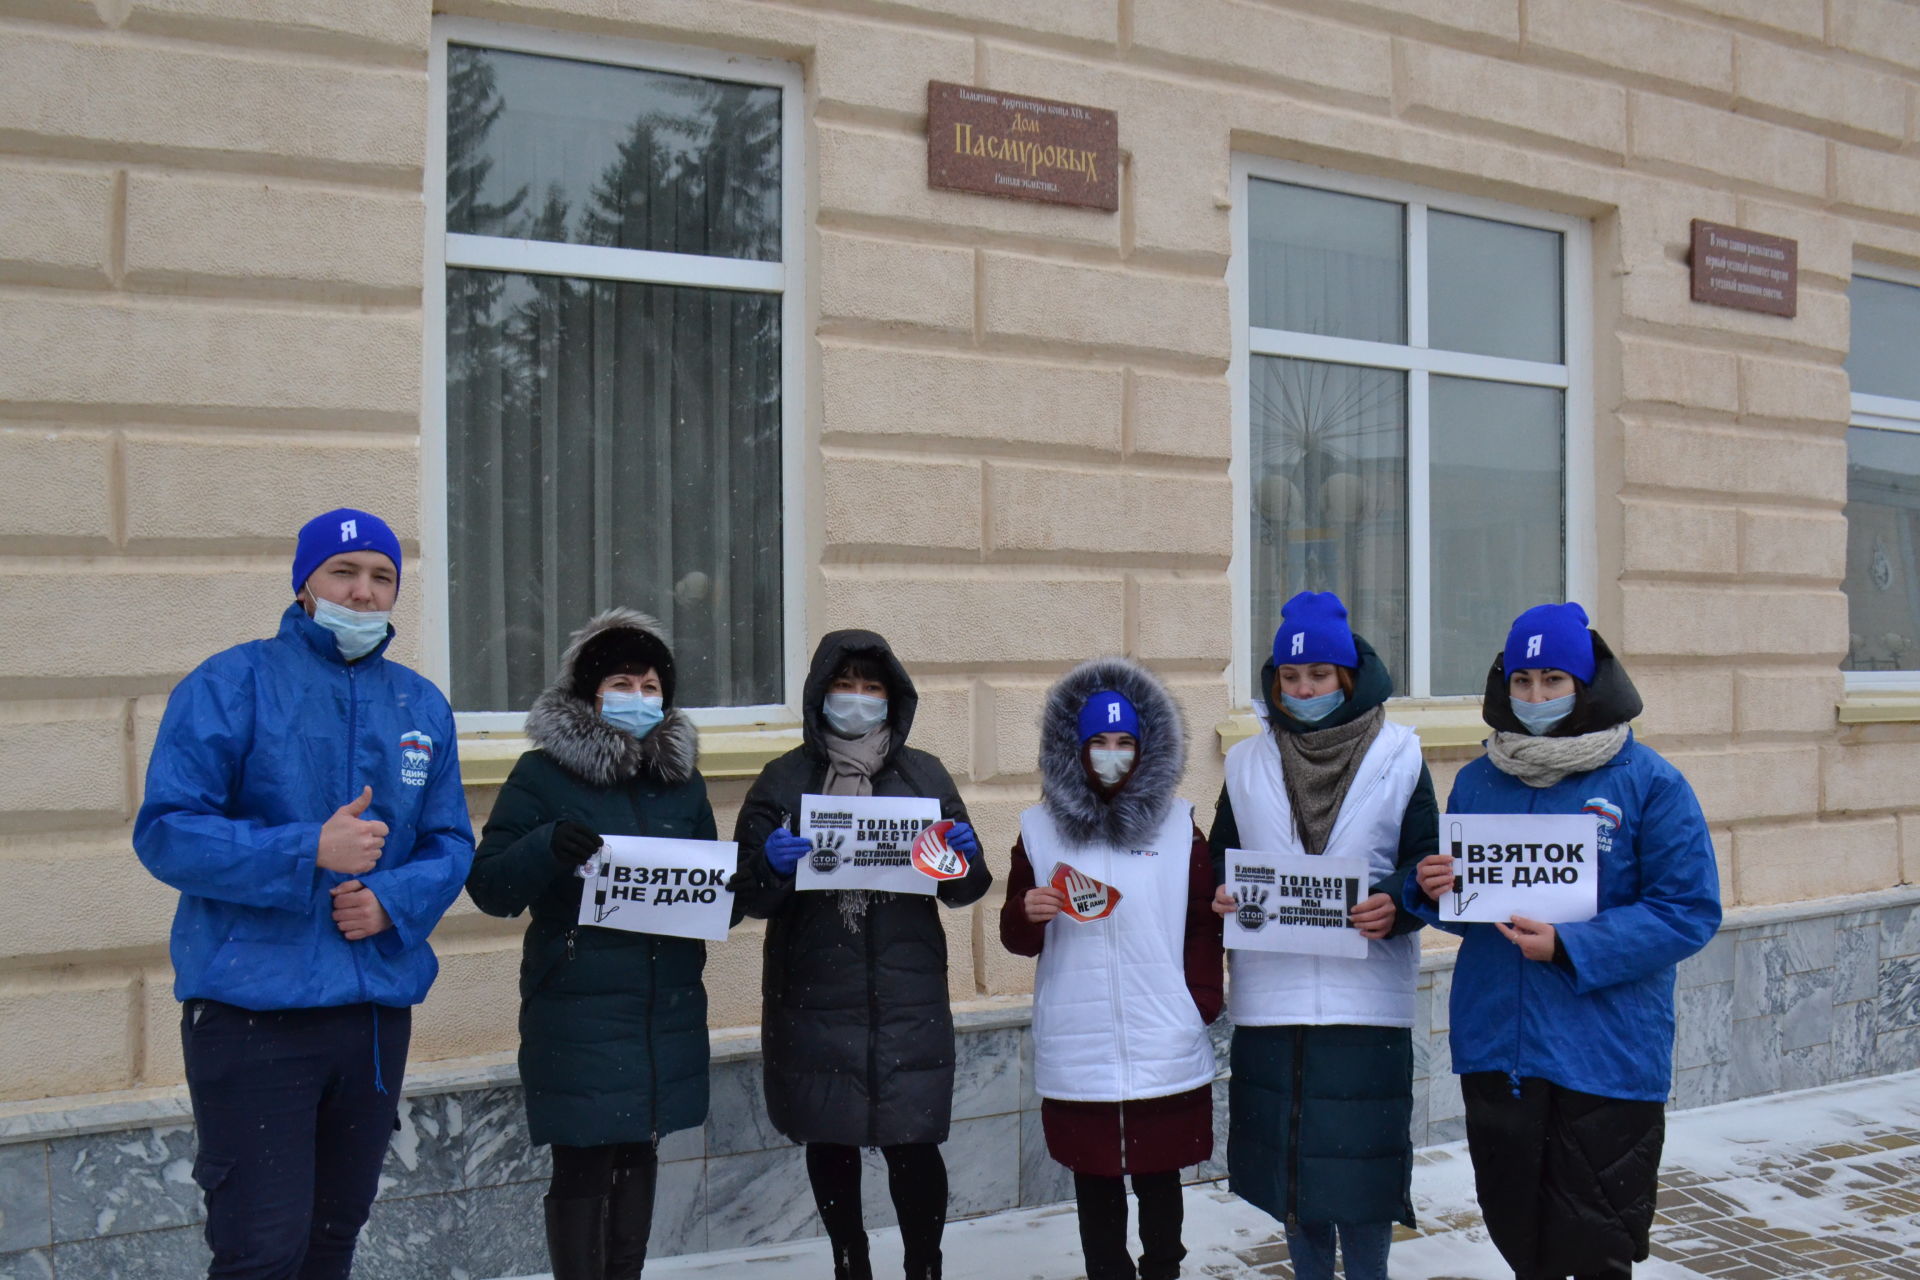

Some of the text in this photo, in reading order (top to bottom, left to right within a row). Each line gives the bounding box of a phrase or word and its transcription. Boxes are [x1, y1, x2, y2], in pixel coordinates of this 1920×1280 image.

[1012, 113, 1040, 133] Дом
[955, 123, 1098, 183] Пасмуровых
[341, 519, 358, 543] Я
[1291, 631, 1305, 656] Я
[1526, 634, 1543, 659] Я
[1107, 702, 1121, 724] Я
[401, 768, 428, 779] ЕДИН
[402, 776, 426, 786] РОСС
[810, 811, 853, 820] 9 декабря
[857, 819, 919, 831] ТОЛЬКО
[1467, 843, 1585, 864] ВЗЯТОК
[614, 866, 725, 887] ВЗЯТОК
[1234, 864, 1276, 875] 9 декабря
[1468, 866, 1579, 888] НЕ ДАЮ
[1280, 875, 1343, 888] ТОЛЬКО
[611, 885, 717, 906] НЕ ДАЮ
[1280, 886, 1342, 900] ВМЕСТЕ
[1076, 900, 1090, 913] НЕ
[1239, 911, 1263, 919] СТОП
[1280, 915, 1343, 928] КОРРУПЦИЮ
